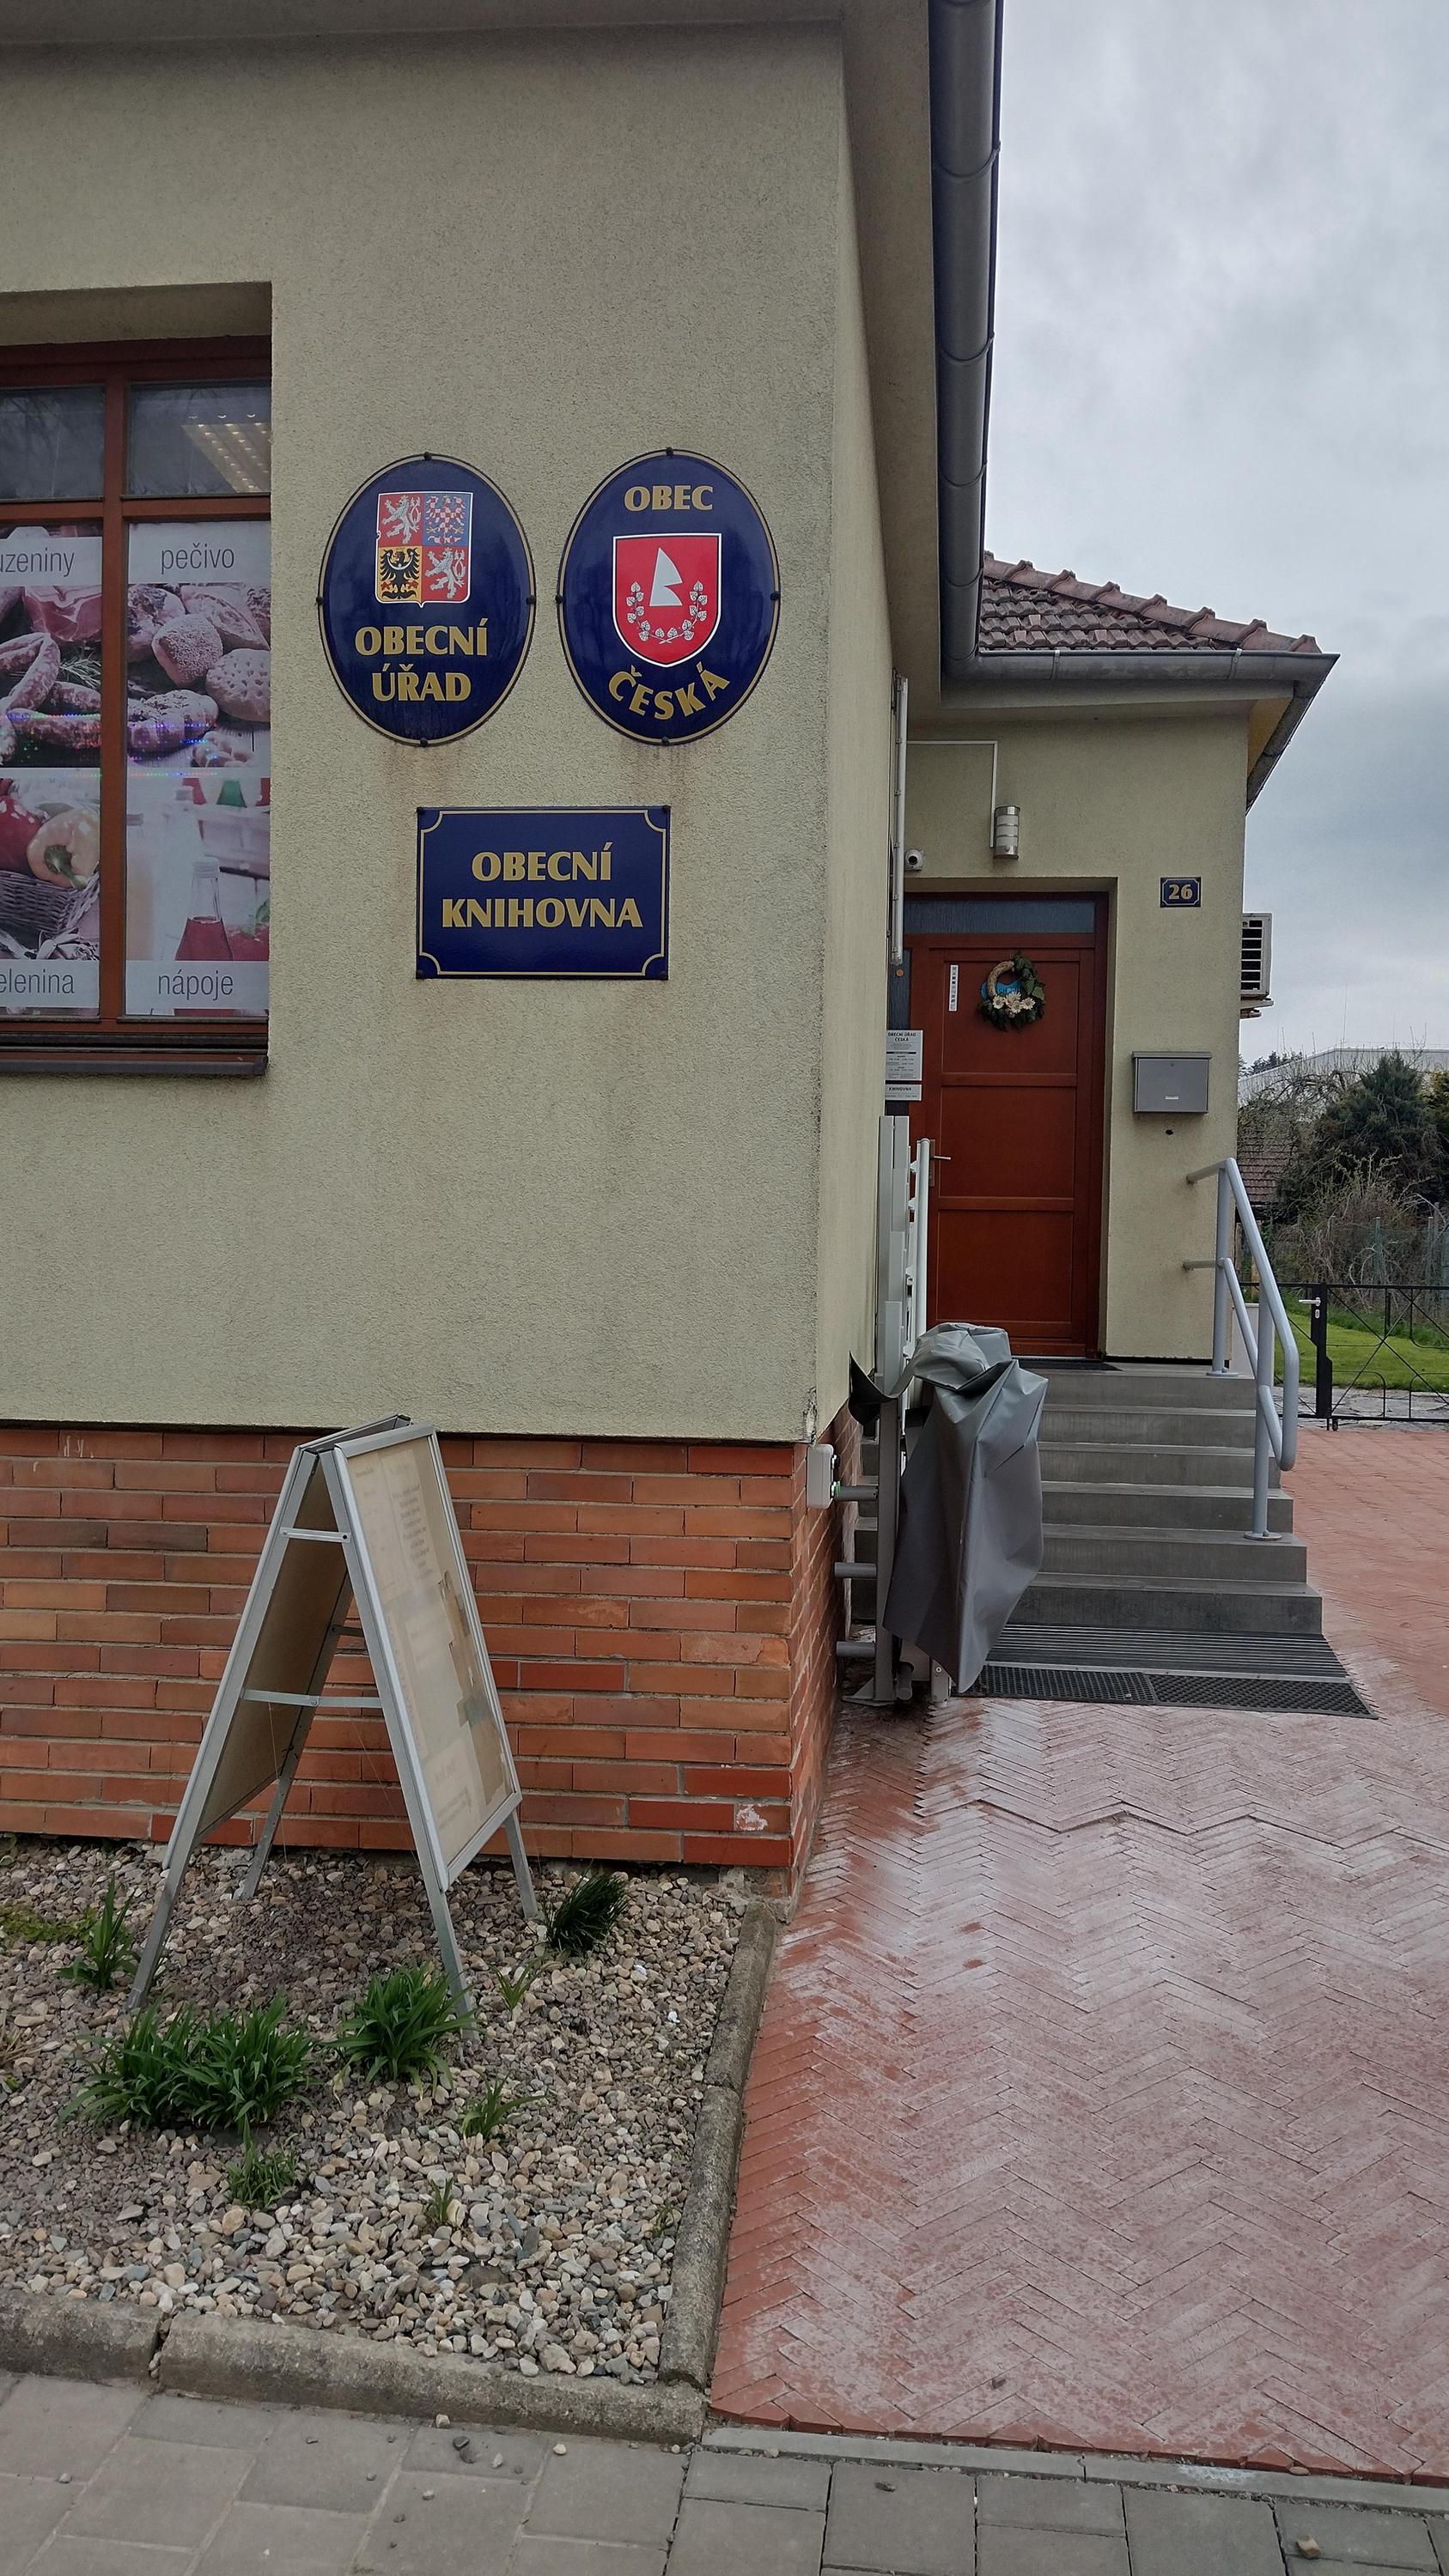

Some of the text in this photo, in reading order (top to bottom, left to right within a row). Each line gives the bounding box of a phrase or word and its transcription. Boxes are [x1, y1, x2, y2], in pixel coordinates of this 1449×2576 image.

[624, 485, 713, 511] OBEC
[0, 547, 75, 578] zeniny
[161, 543, 234, 574] pečivo
[355, 618, 488, 656] OBECNÍ
[372, 663, 472, 702] ÚŘAD
[608, 663, 730, 720] ČESKÁ
[472, 842, 612, 882] OBECNÍ
[1169, 884, 1193, 900] 26
[442, 897, 643, 927] KNIHOVNA
[158, 969, 234, 1000] nápoje
